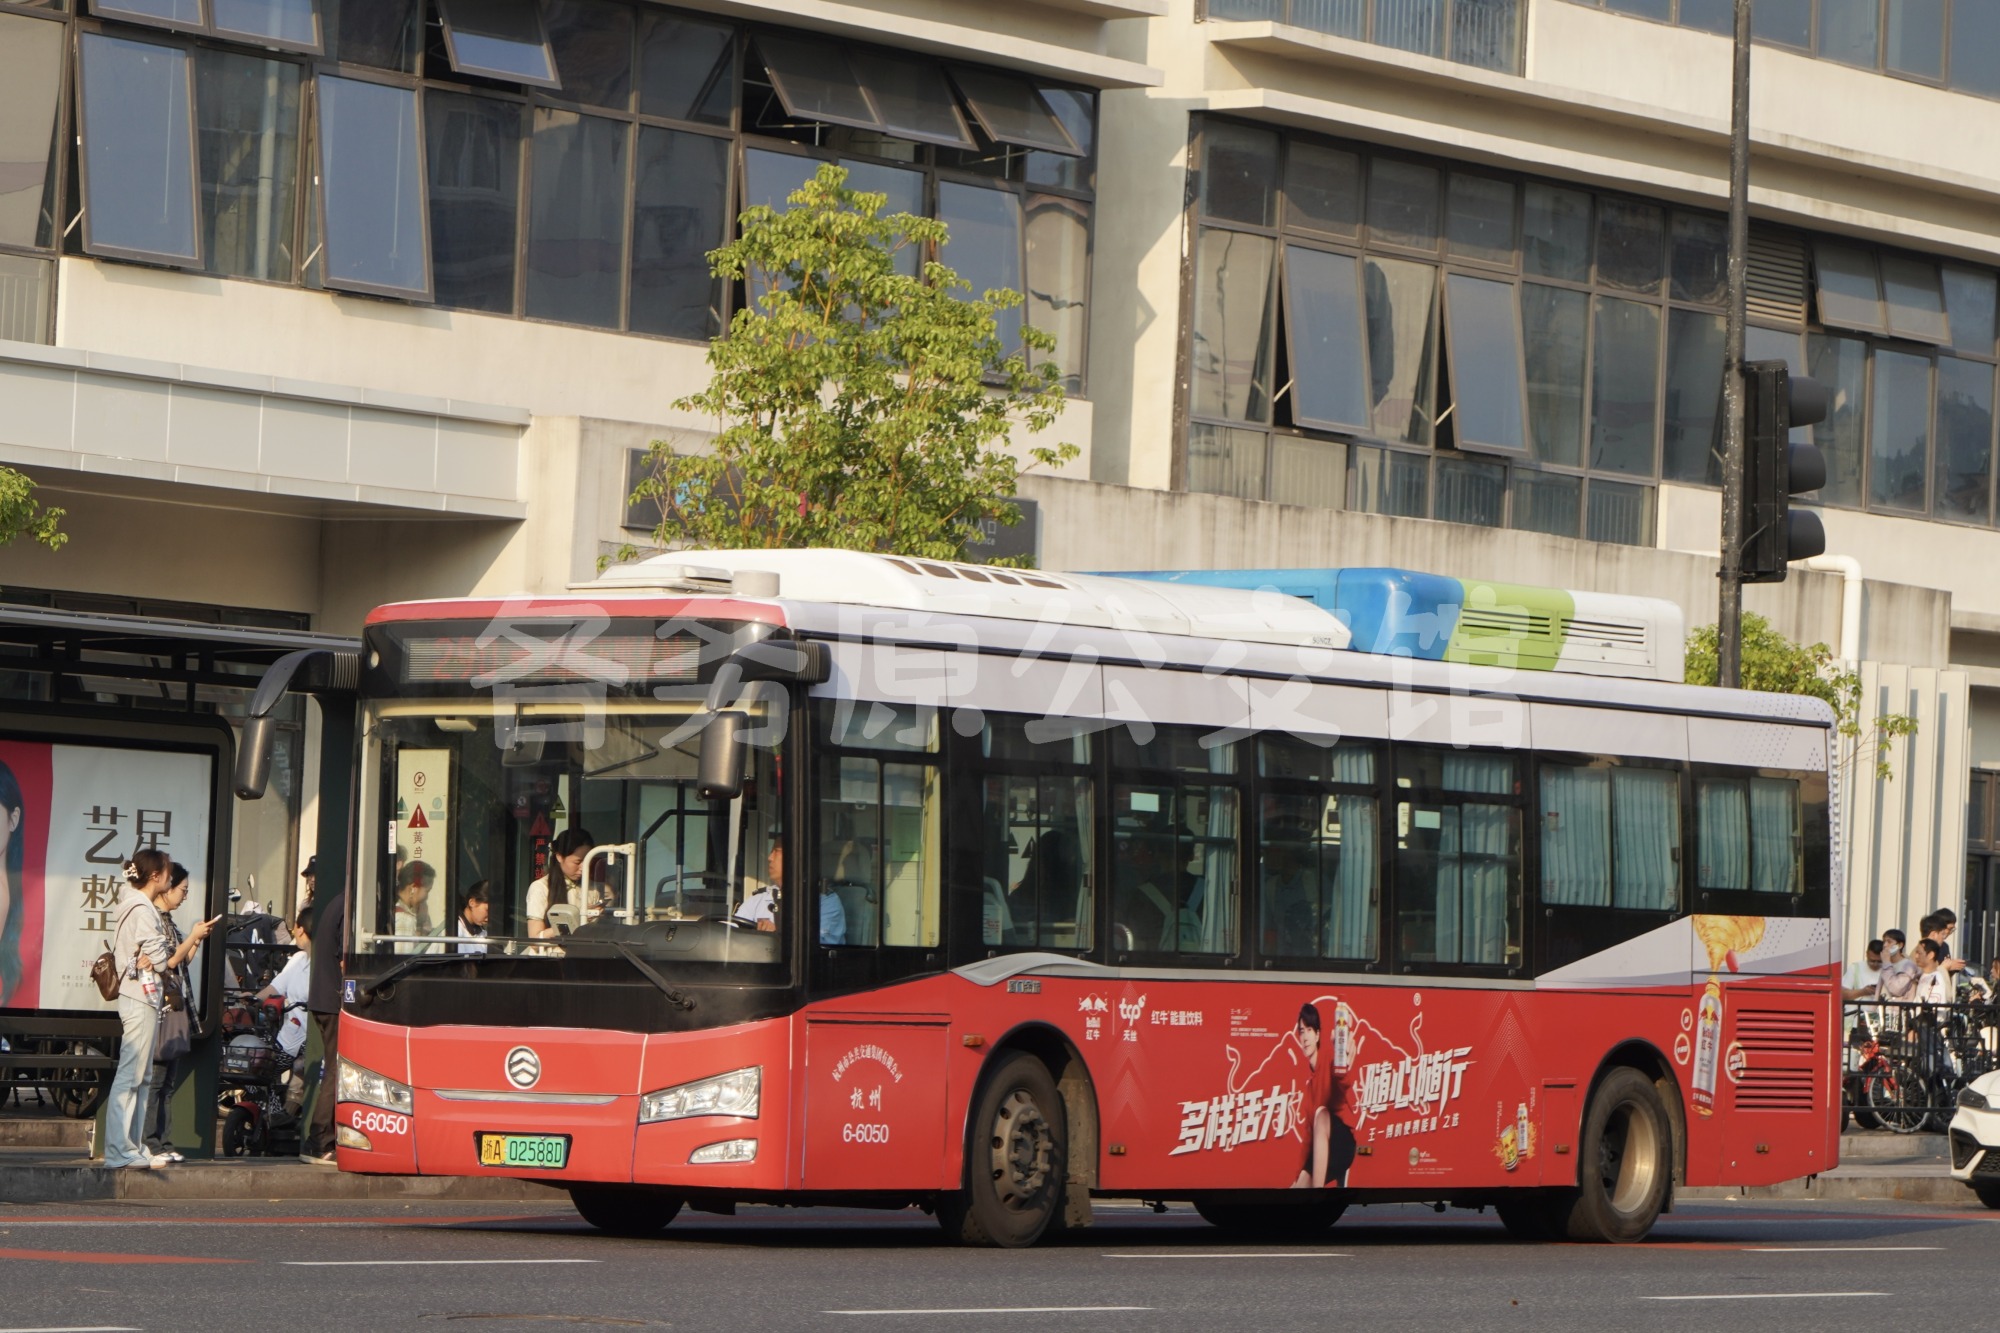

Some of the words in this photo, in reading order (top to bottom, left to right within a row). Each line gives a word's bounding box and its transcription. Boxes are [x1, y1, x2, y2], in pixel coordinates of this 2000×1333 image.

[1086, 1030, 1100, 1040] 红牛
[1123, 1030, 1137, 1041] 天丝
[850, 1085, 882, 1112] 杭州
[1357, 1046, 1477, 1130] 随心随行
[352, 1110, 408, 1135] 6-6050
[1168, 1085, 1288, 1156] 多样活力
[843, 1123, 889, 1144] 6-6050
